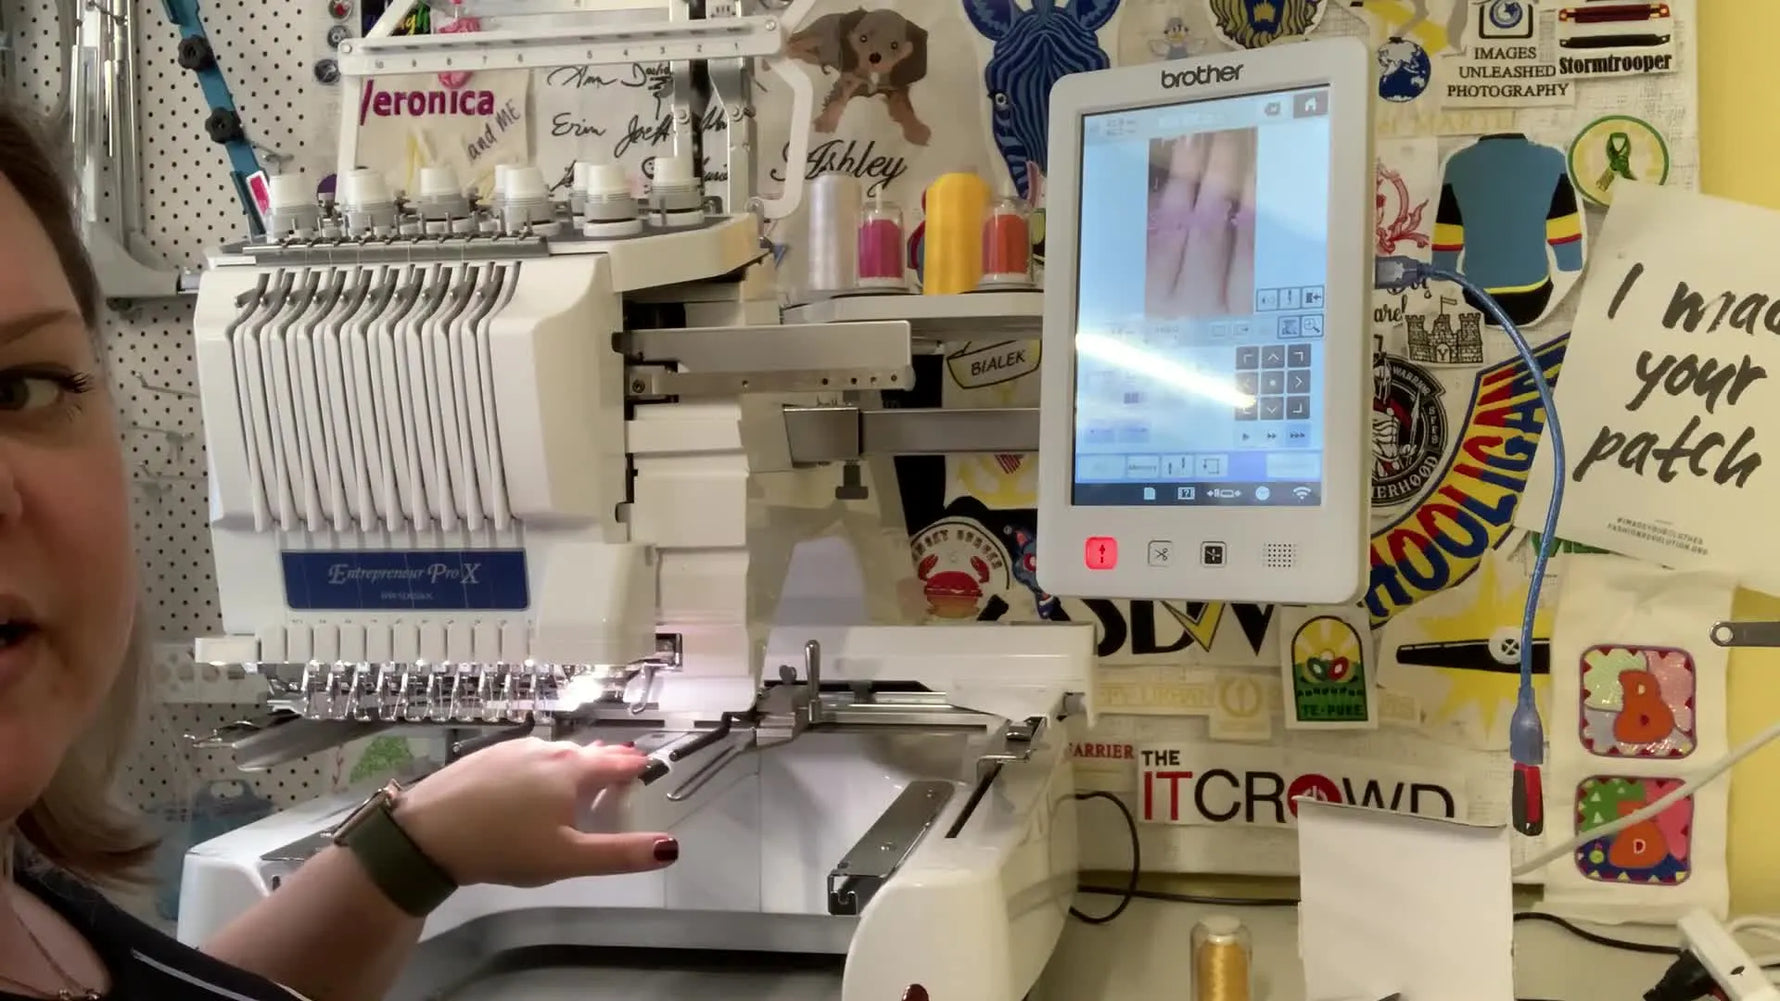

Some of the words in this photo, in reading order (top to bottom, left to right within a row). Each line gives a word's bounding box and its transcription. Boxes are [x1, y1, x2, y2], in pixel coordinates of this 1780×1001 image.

[1474, 46, 1537, 60] IMAGES
[1559, 54, 1672, 75] Stormtrooper
[1161, 64, 1244, 89] brother
[1459, 64, 1556, 79] UNLEASHED
[1448, 83, 1570, 98] PHOTOGRAPHY
[467, 122, 498, 162] and
[495, 99, 521, 133] ME
[770, 139, 908, 198] Ashley
[1607, 262, 1644, 320] I
[971, 350, 1026, 377] BIALEK
[1624, 350, 1768, 414] your
[1572, 415, 1762, 489] patch
[328, 563, 424, 585] Entrepreneur
[427, 563, 460, 584] Pro
[1068, 743, 1134, 759] ARRIER
[1142, 750, 1180, 767] THE
